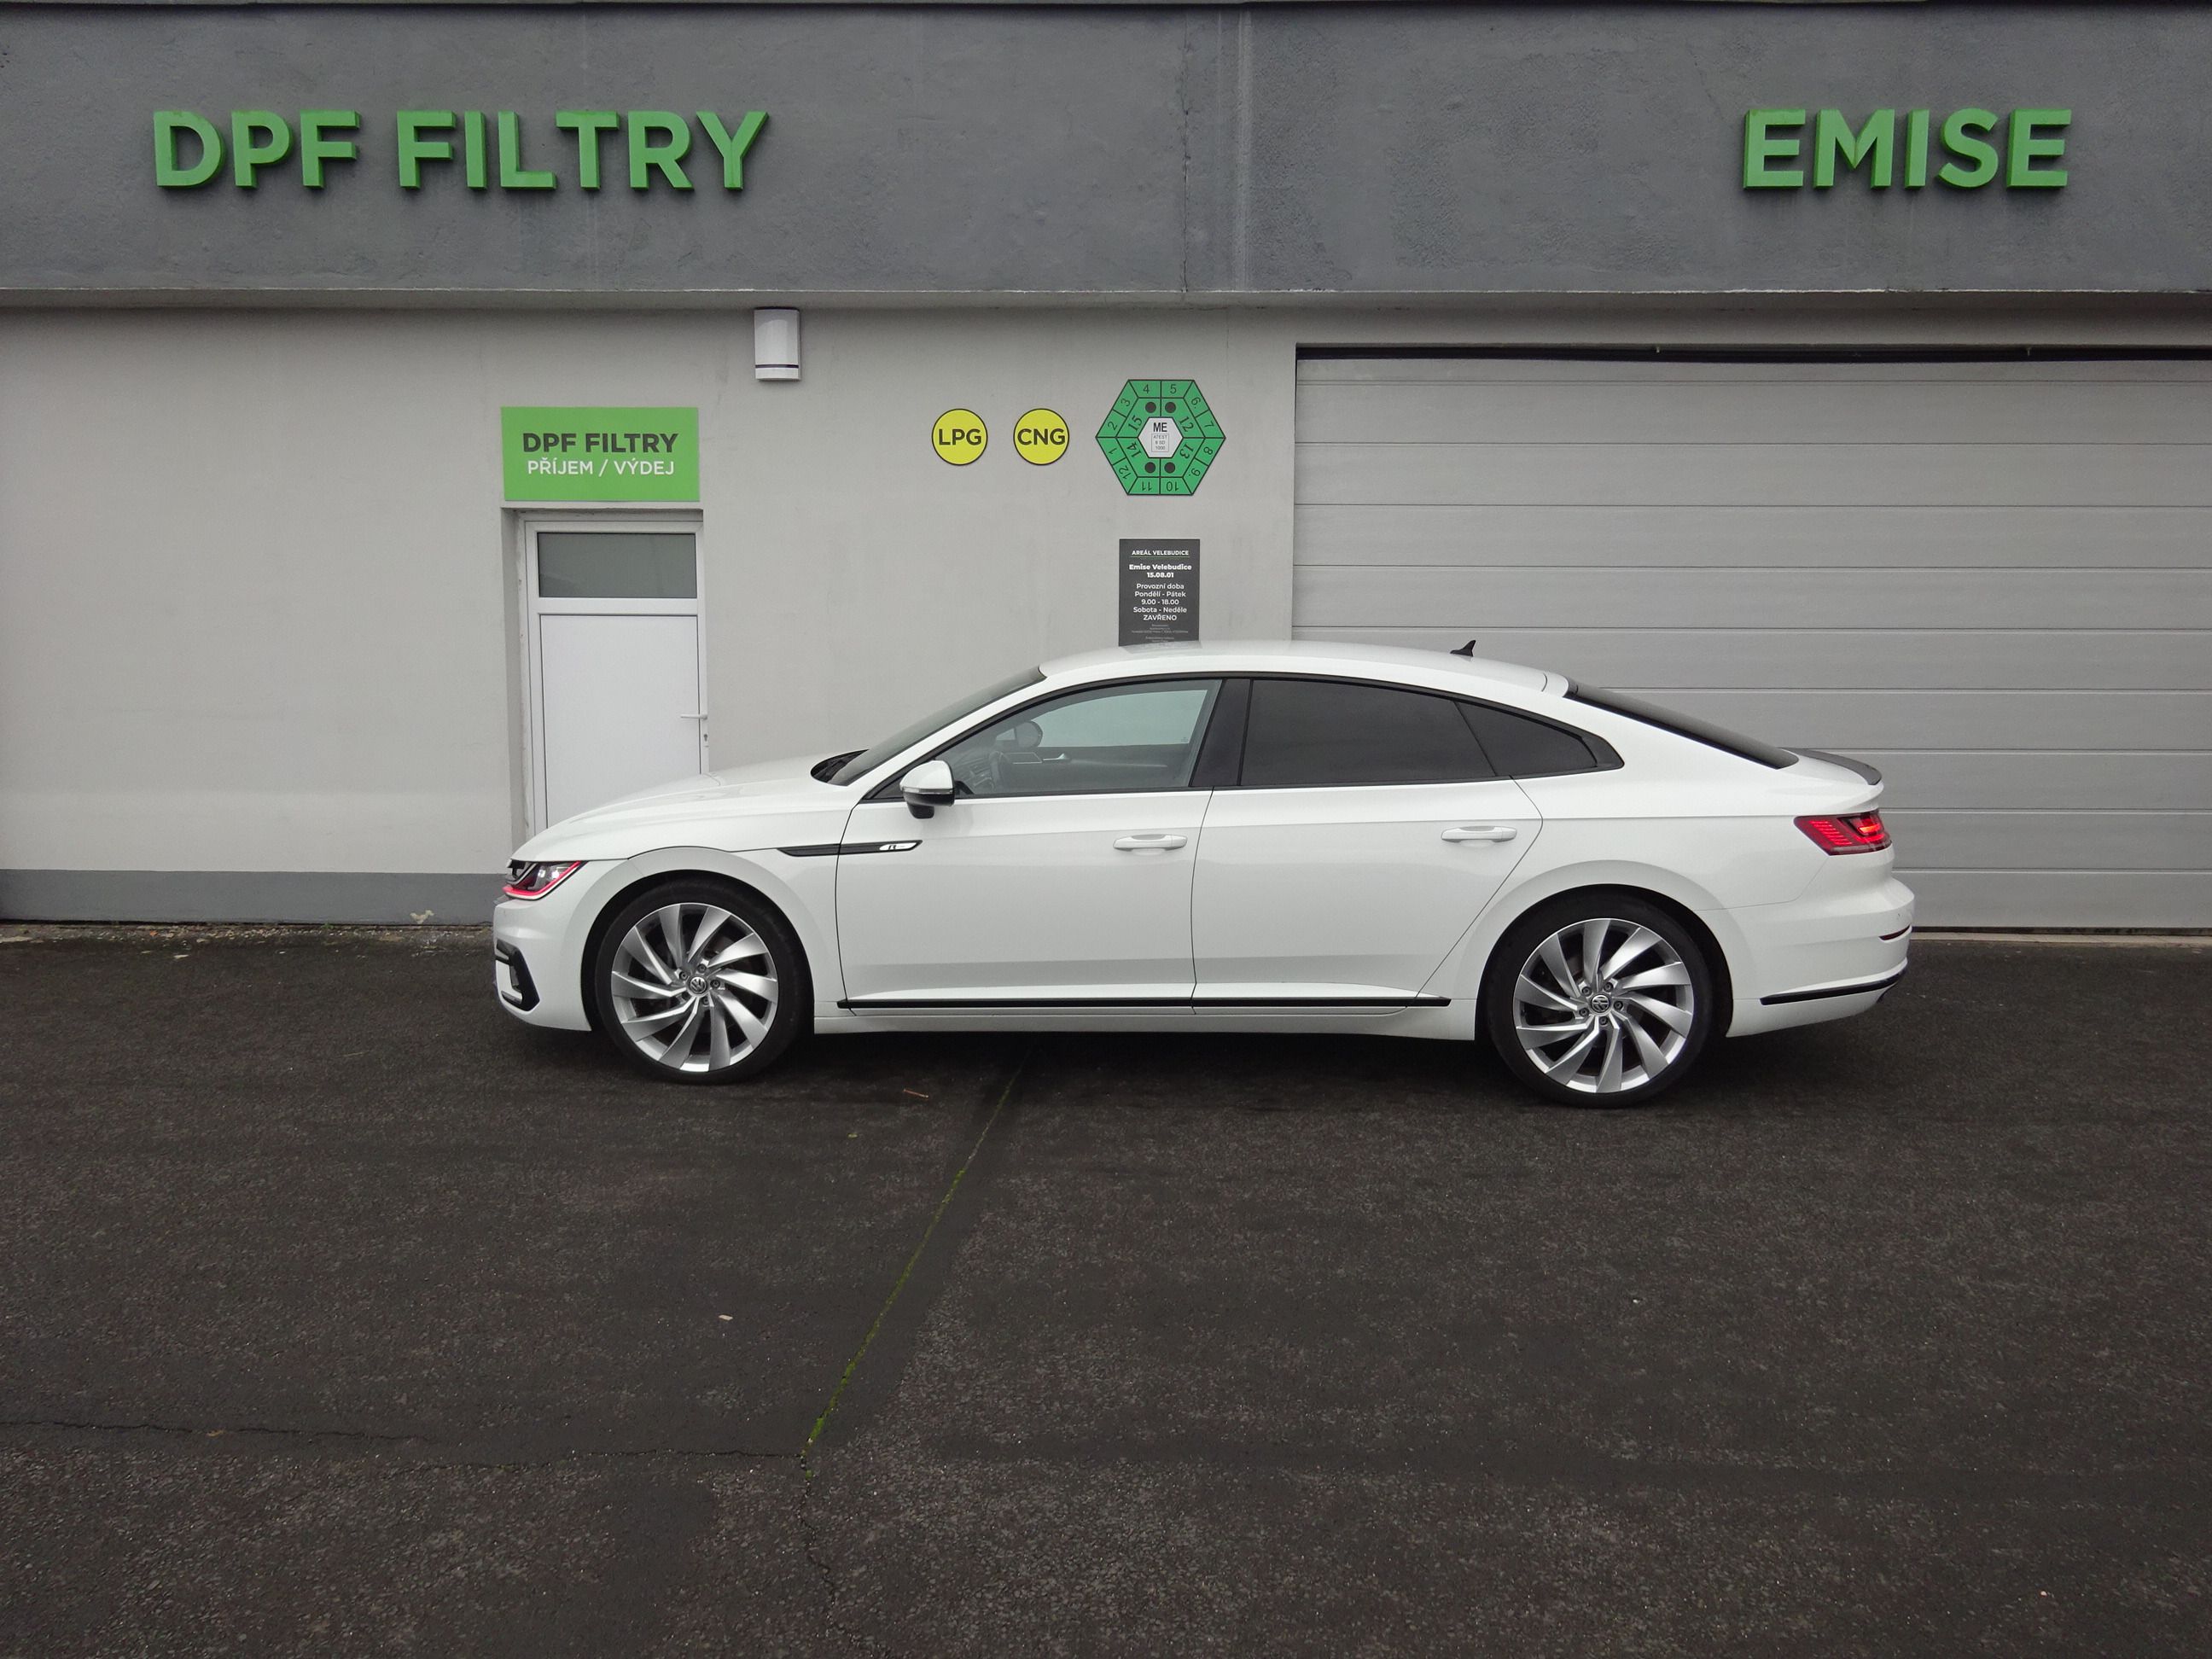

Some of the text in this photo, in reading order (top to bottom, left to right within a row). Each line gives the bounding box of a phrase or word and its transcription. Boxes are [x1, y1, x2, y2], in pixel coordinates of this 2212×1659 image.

[154, 110, 768, 189] DPF FILTRY
[1743, 108, 2072, 189] EMISE
[1143, 384, 1150, 393] 4
[1169, 384, 1177, 393] 5
[1121, 398, 1131, 406] 3
[1108, 421, 1117, 431] 2
[1128, 415, 1143, 432] 15
[1153, 422, 1167, 433] ME
[1179, 416, 1194, 432] 12
[522, 433, 679, 453] DPF FILTRY
[939, 428, 982, 445] LPG
[1017, 428, 1066, 445] CNG
[1126, 442, 1142, 457] 14
[1179, 443, 1194, 459] 13
[1203, 446, 1214, 455] 8
[527, 457, 675, 477] PŘÍJEM / VÝDEJ
[1119, 465, 1132, 479] 12
[1142, 481, 1152, 492] 11
[1166, 480, 1179, 492] 10
